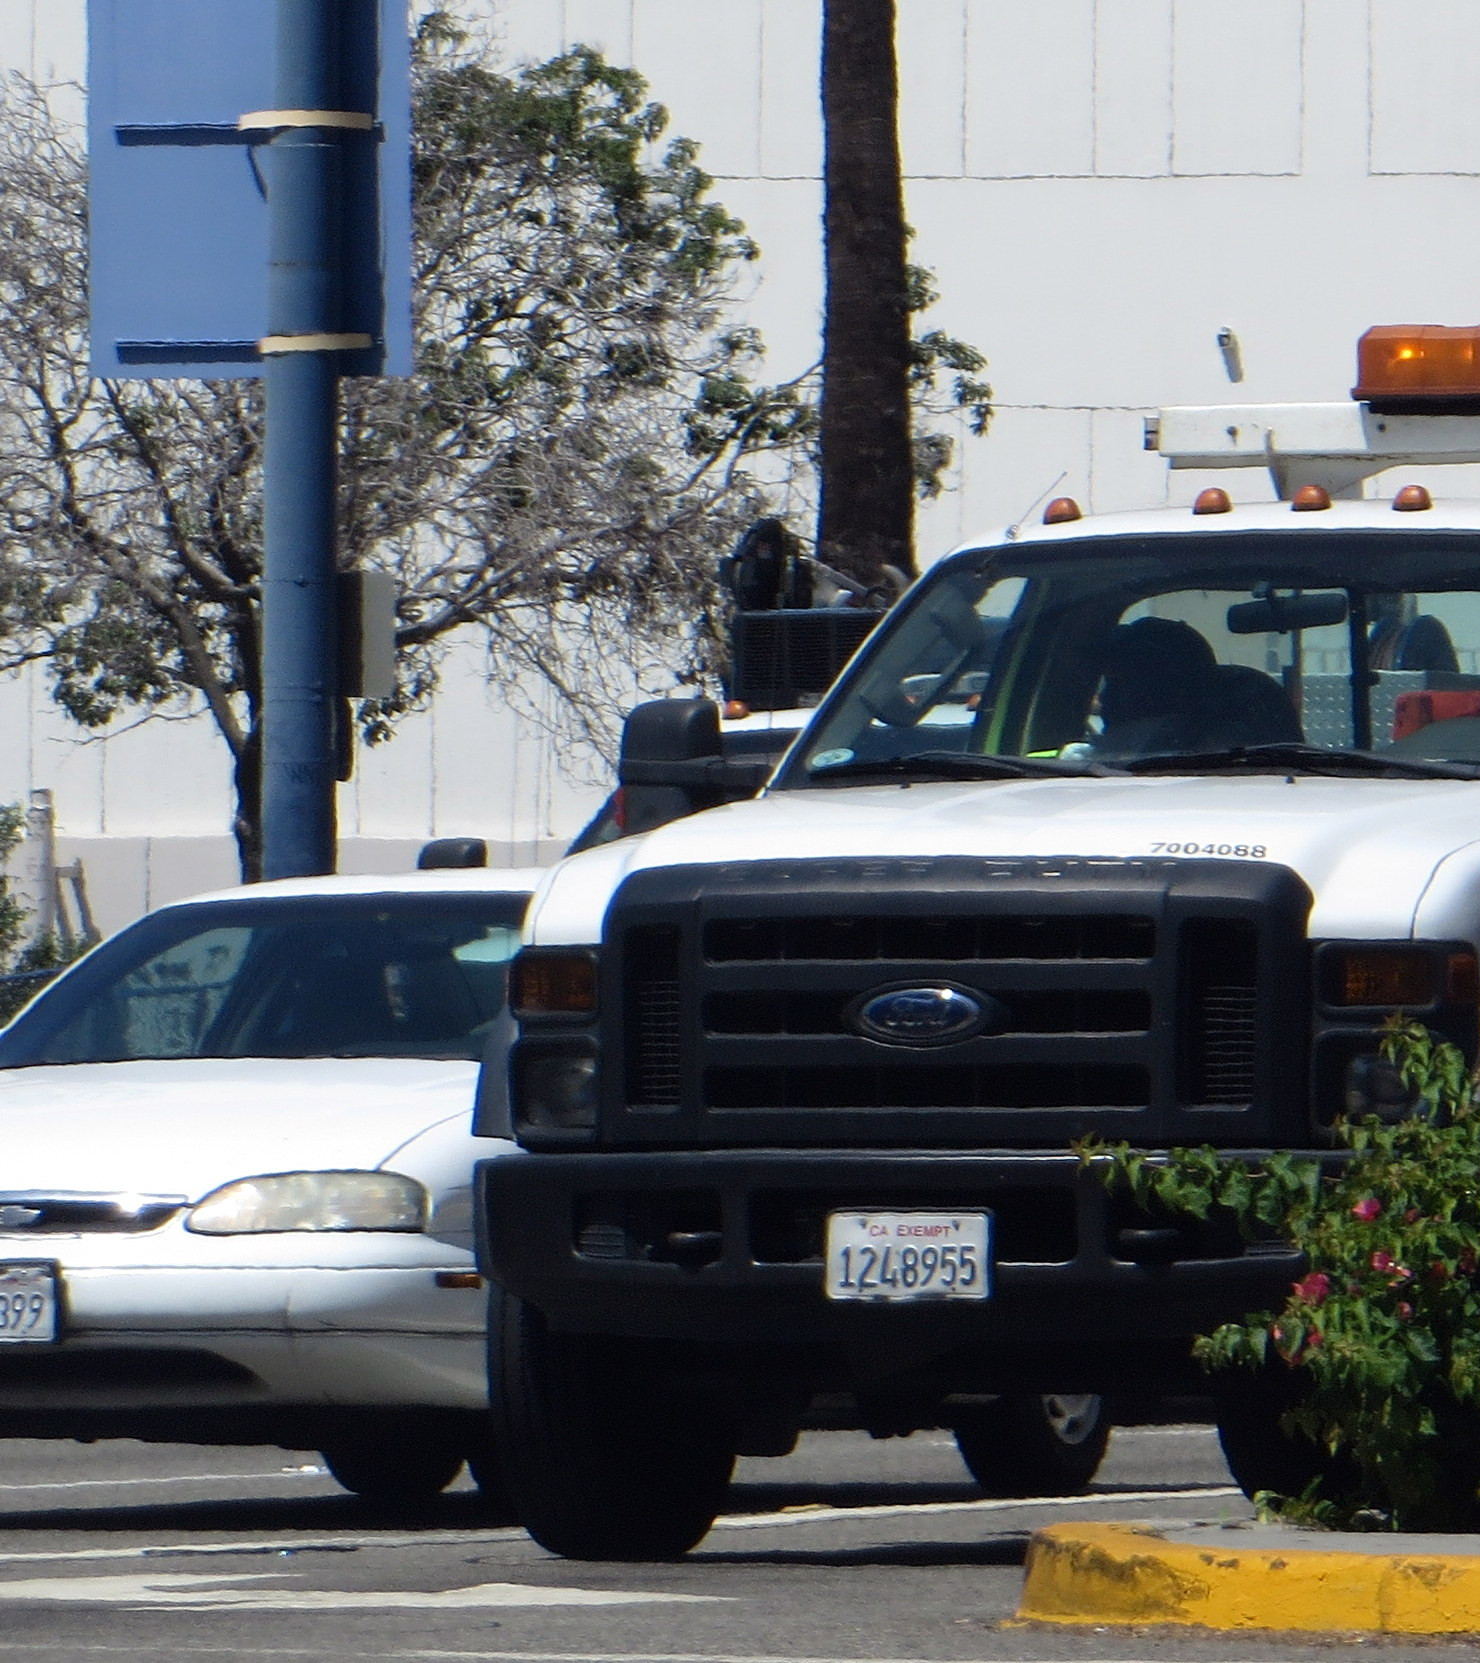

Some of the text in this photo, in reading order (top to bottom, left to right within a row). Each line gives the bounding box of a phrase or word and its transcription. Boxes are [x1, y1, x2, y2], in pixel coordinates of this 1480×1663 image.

[1150, 842, 1268, 859] 7004088
[869, 1224, 951, 1238] CA EXEMPT
[839, 1244, 977, 1288] 1248955
